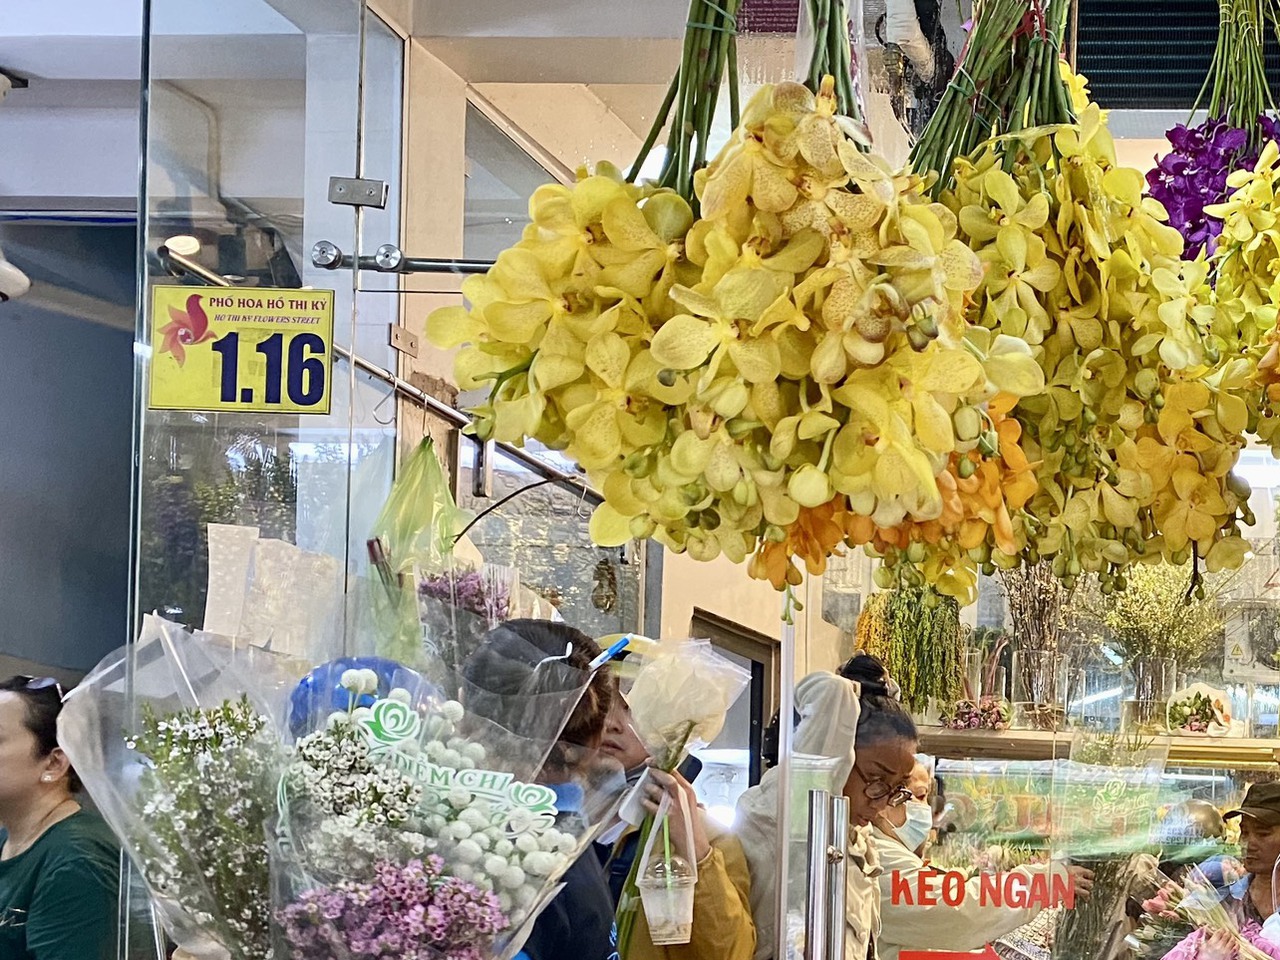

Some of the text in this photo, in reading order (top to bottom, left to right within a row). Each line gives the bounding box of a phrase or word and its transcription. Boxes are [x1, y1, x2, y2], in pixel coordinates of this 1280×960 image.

[237, 298, 263, 308] HOA
[253, 315, 290, 323] FLOWERS
[291, 317, 321, 325] STREET
[212, 331, 326, 406] 1.16
[458, 771, 509, 791] CHI
[890, 860, 1076, 909] KÉO NGAN
